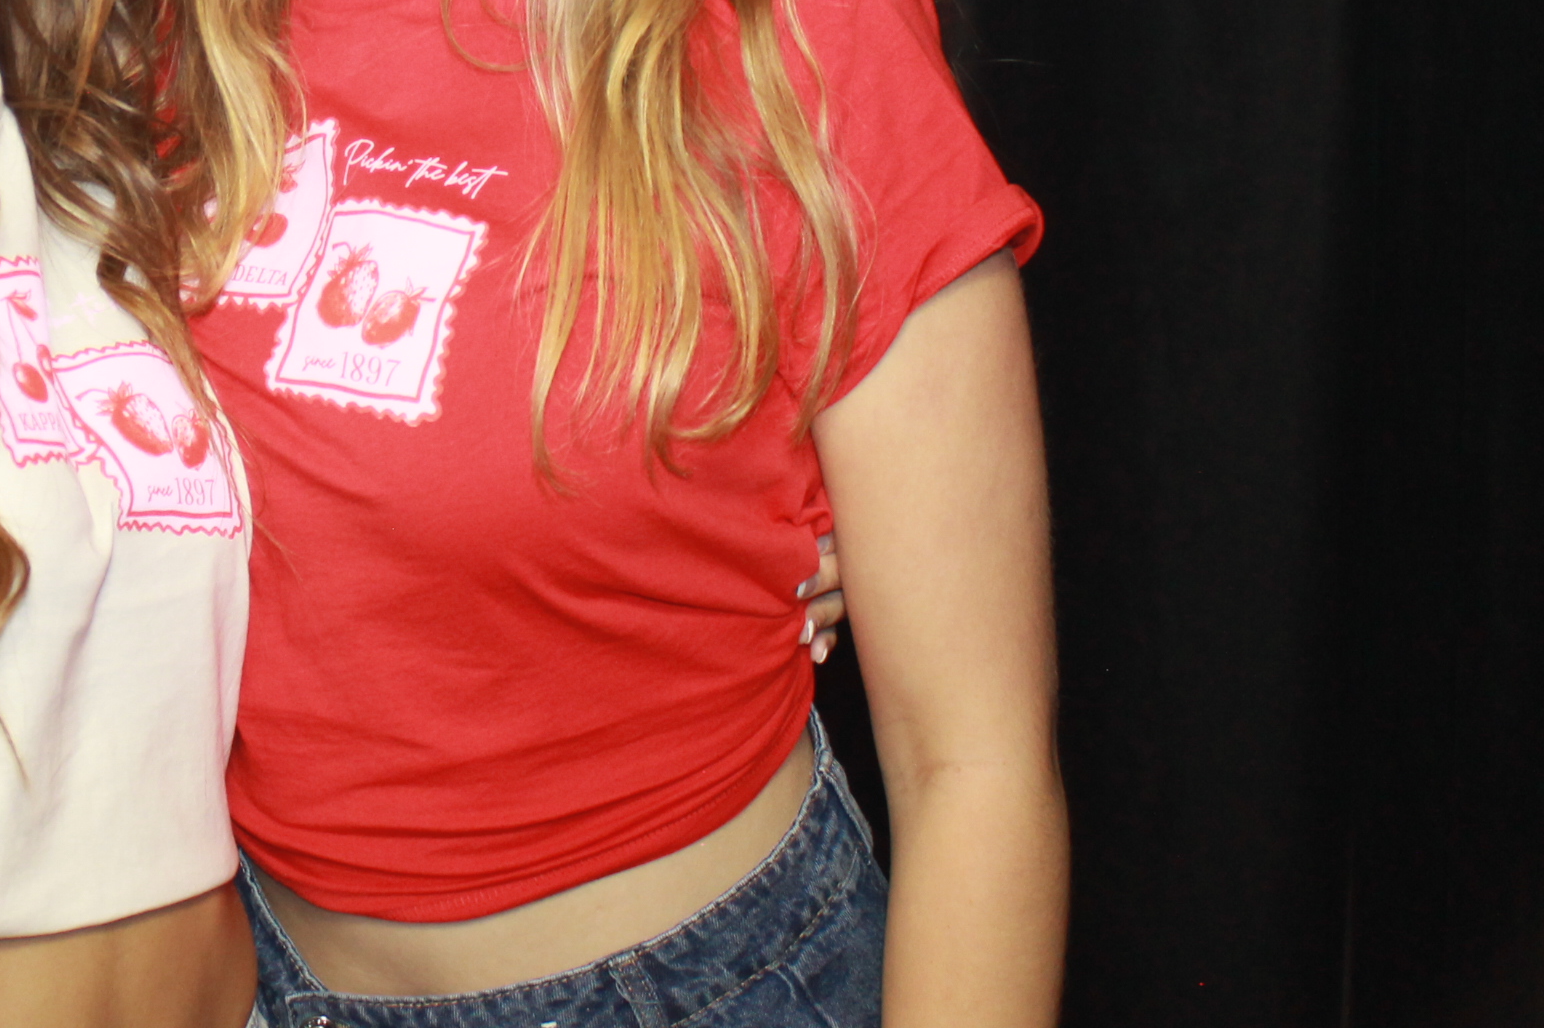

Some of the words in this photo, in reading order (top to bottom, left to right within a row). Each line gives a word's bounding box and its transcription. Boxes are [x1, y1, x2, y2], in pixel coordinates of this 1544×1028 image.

[405, 157, 448, 188] the
[444, 161, 509, 200] best
[231, 264, 288, 286] DELTA
[302, 355, 336, 372] since
[340, 351, 402, 387] 1897
[147, 485, 173, 503] since
[174, 477, 215, 506] 1897
